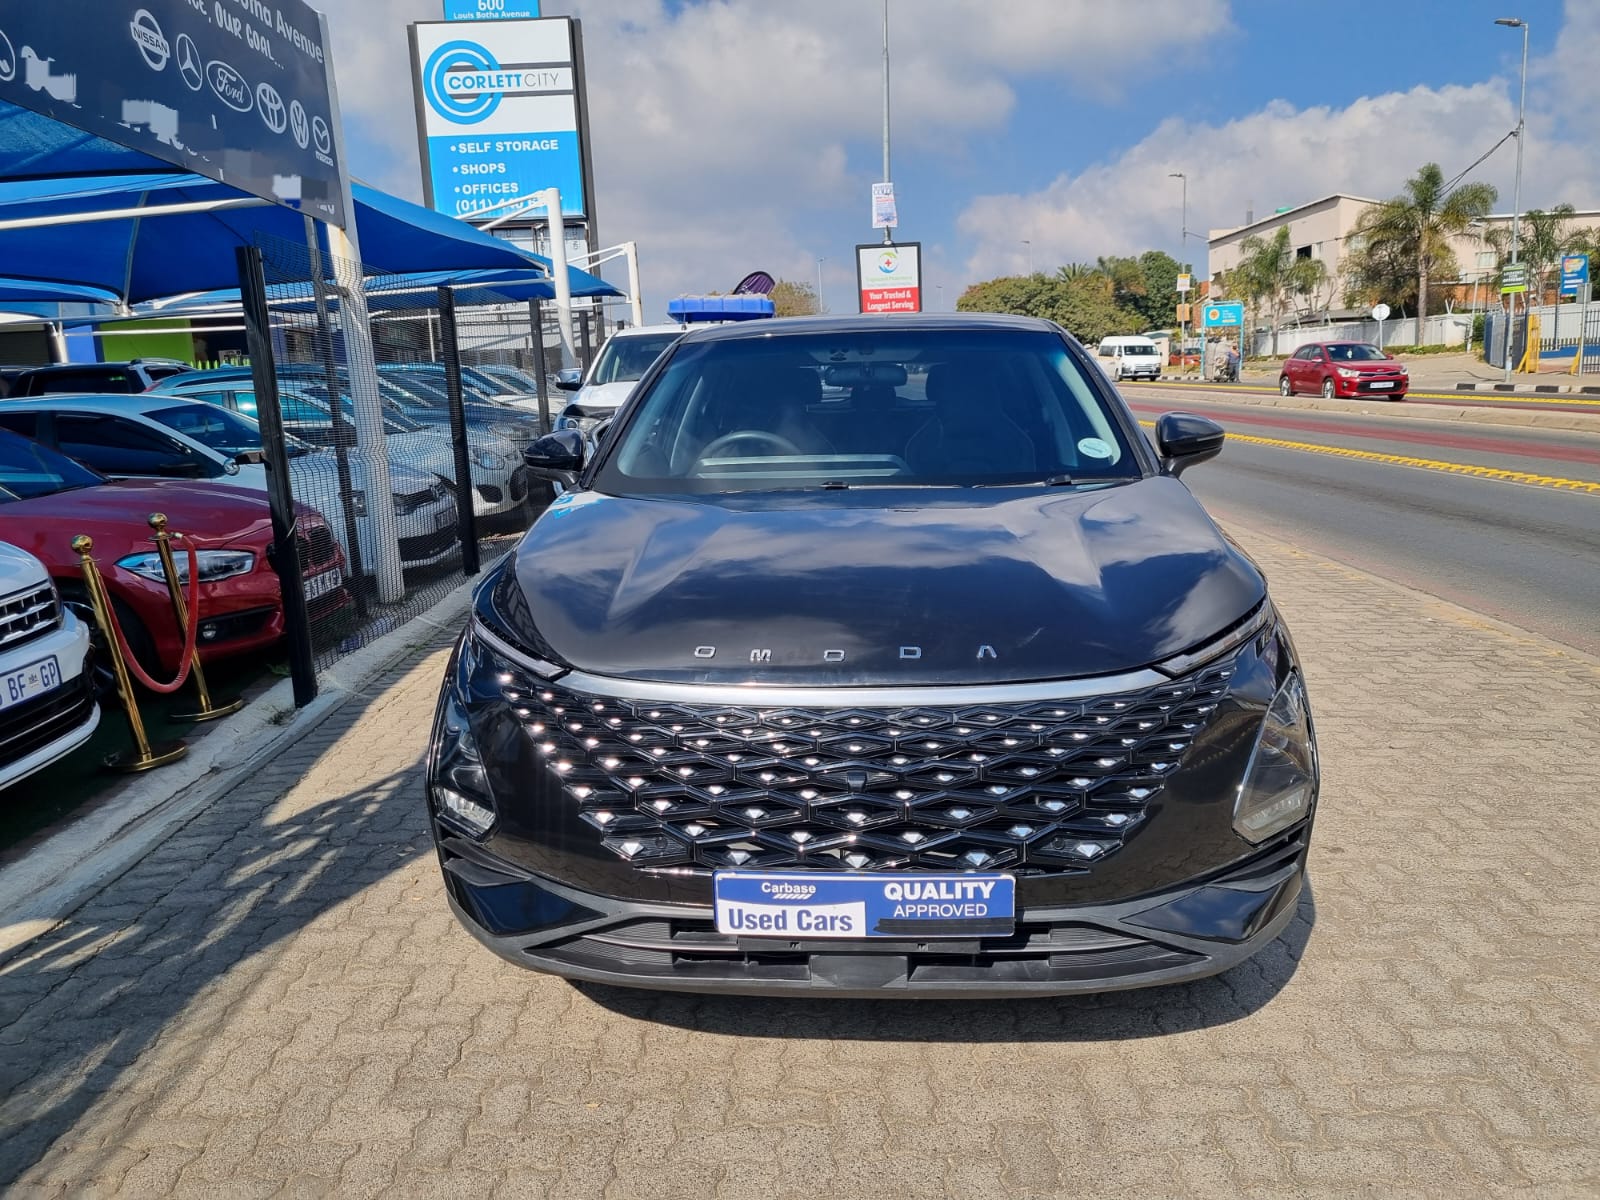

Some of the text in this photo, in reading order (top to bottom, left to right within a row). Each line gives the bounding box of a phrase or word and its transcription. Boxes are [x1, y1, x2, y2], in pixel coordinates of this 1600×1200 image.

[478, 0, 504, 11] 600
[453, 10, 531, 19] Louis Botha Avenue
[132, 25, 168, 55] NISSAN
[277, 10, 323, 63] Avenue
[216, 67, 244, 104] Ford
[448, 73, 522, 90] CORLETT
[458, 139, 559, 154] SELF STORAGE
[460, 163, 506, 175] SHOPS
[462, 182, 519, 195] OFFICES
[694, 645, 998, 663] OMODA
[8, 662, 56, 701] BF GP
[761, 881, 995, 901] Carbase QUALITY
[893, 903, 988, 918] APPROVED
[728, 908, 853, 932] Used Cars
